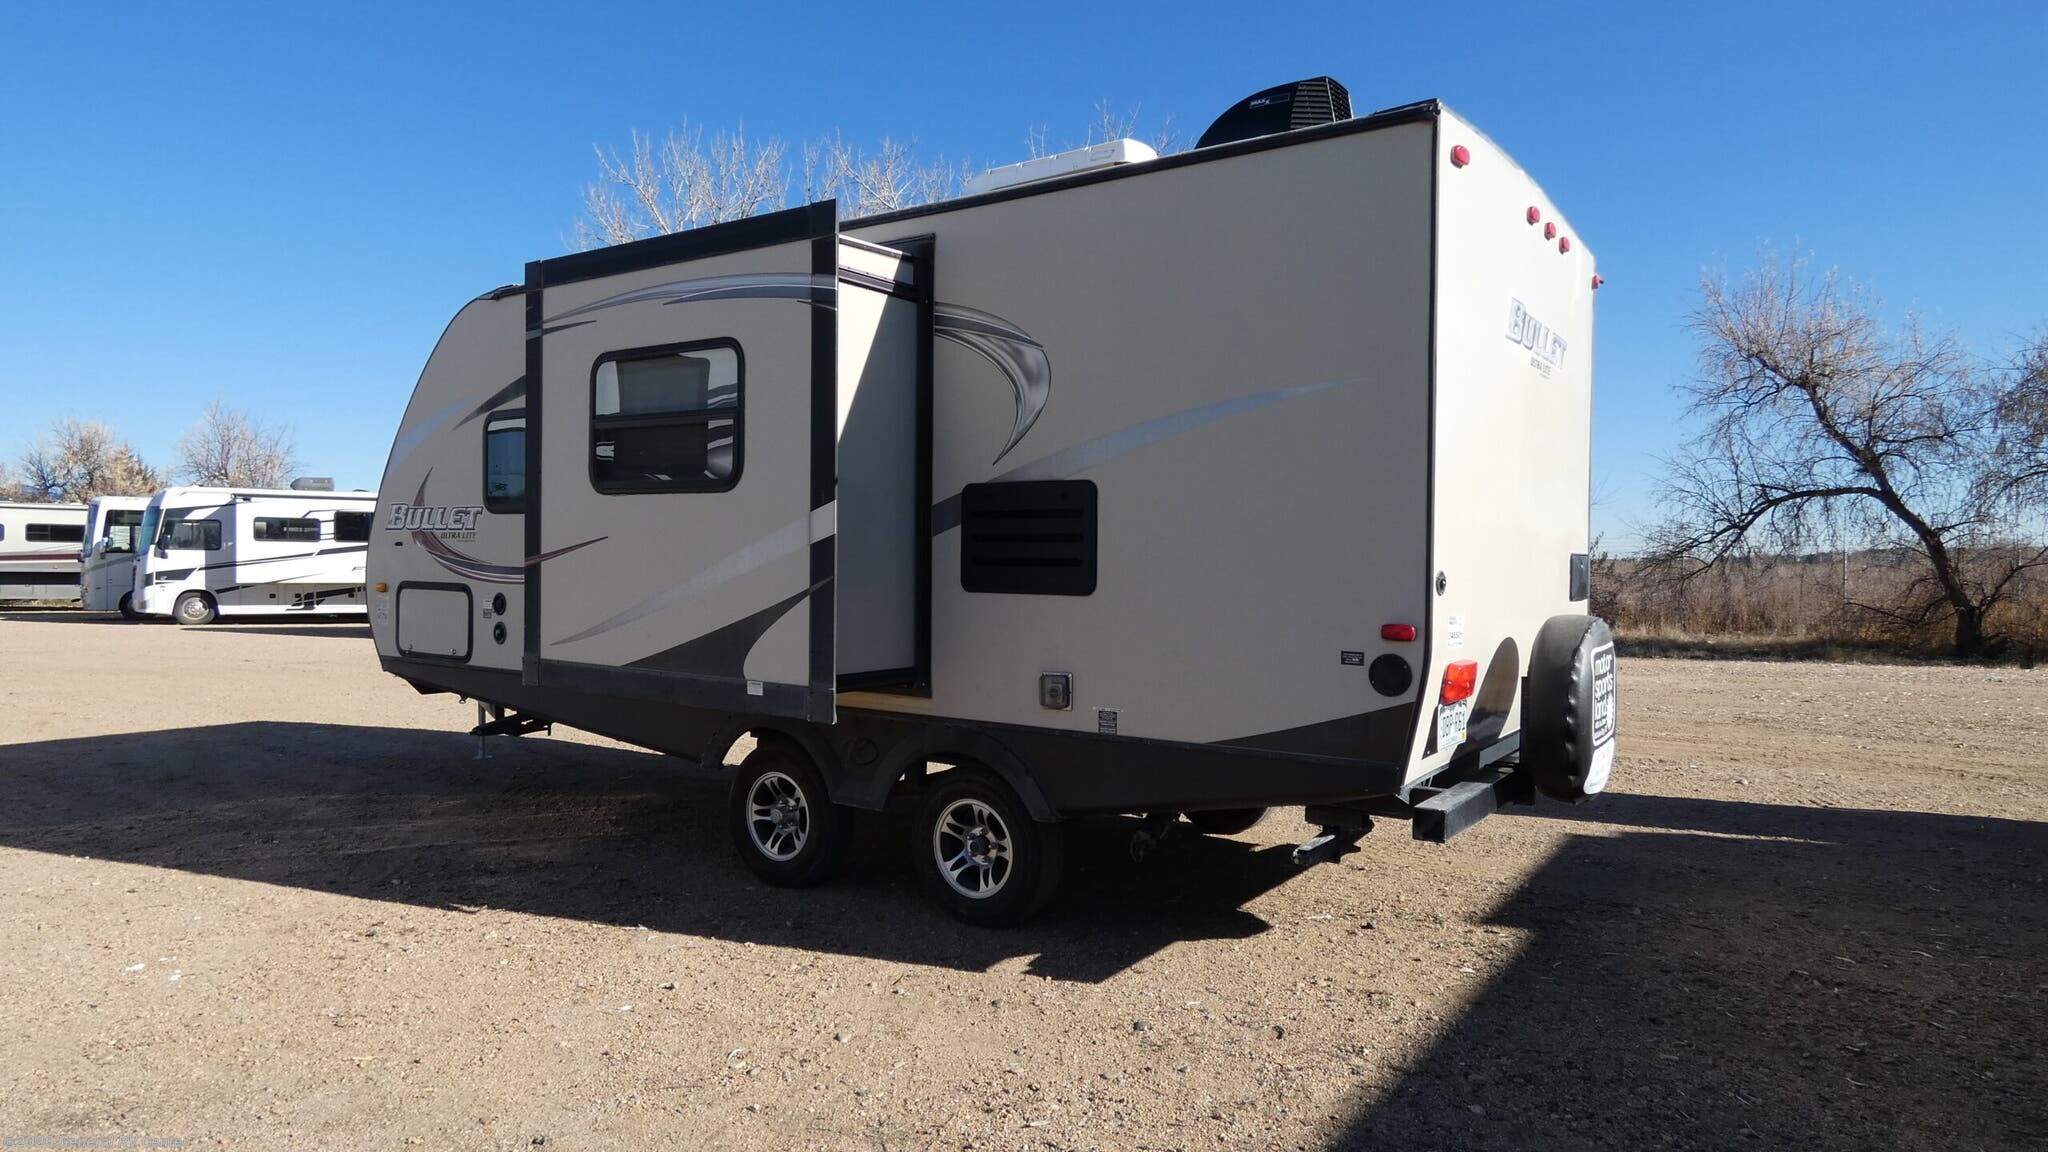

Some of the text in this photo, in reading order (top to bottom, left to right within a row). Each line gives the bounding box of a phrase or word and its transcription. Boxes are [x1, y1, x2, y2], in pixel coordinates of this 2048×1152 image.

[1505, 296, 1568, 370] BULLET
[385, 503, 484, 531] BULLET
[440, 531, 477, 540] ULTRA LITE
[1595, 653, 1613, 676] motor
[1595, 672, 1614, 701] sports
